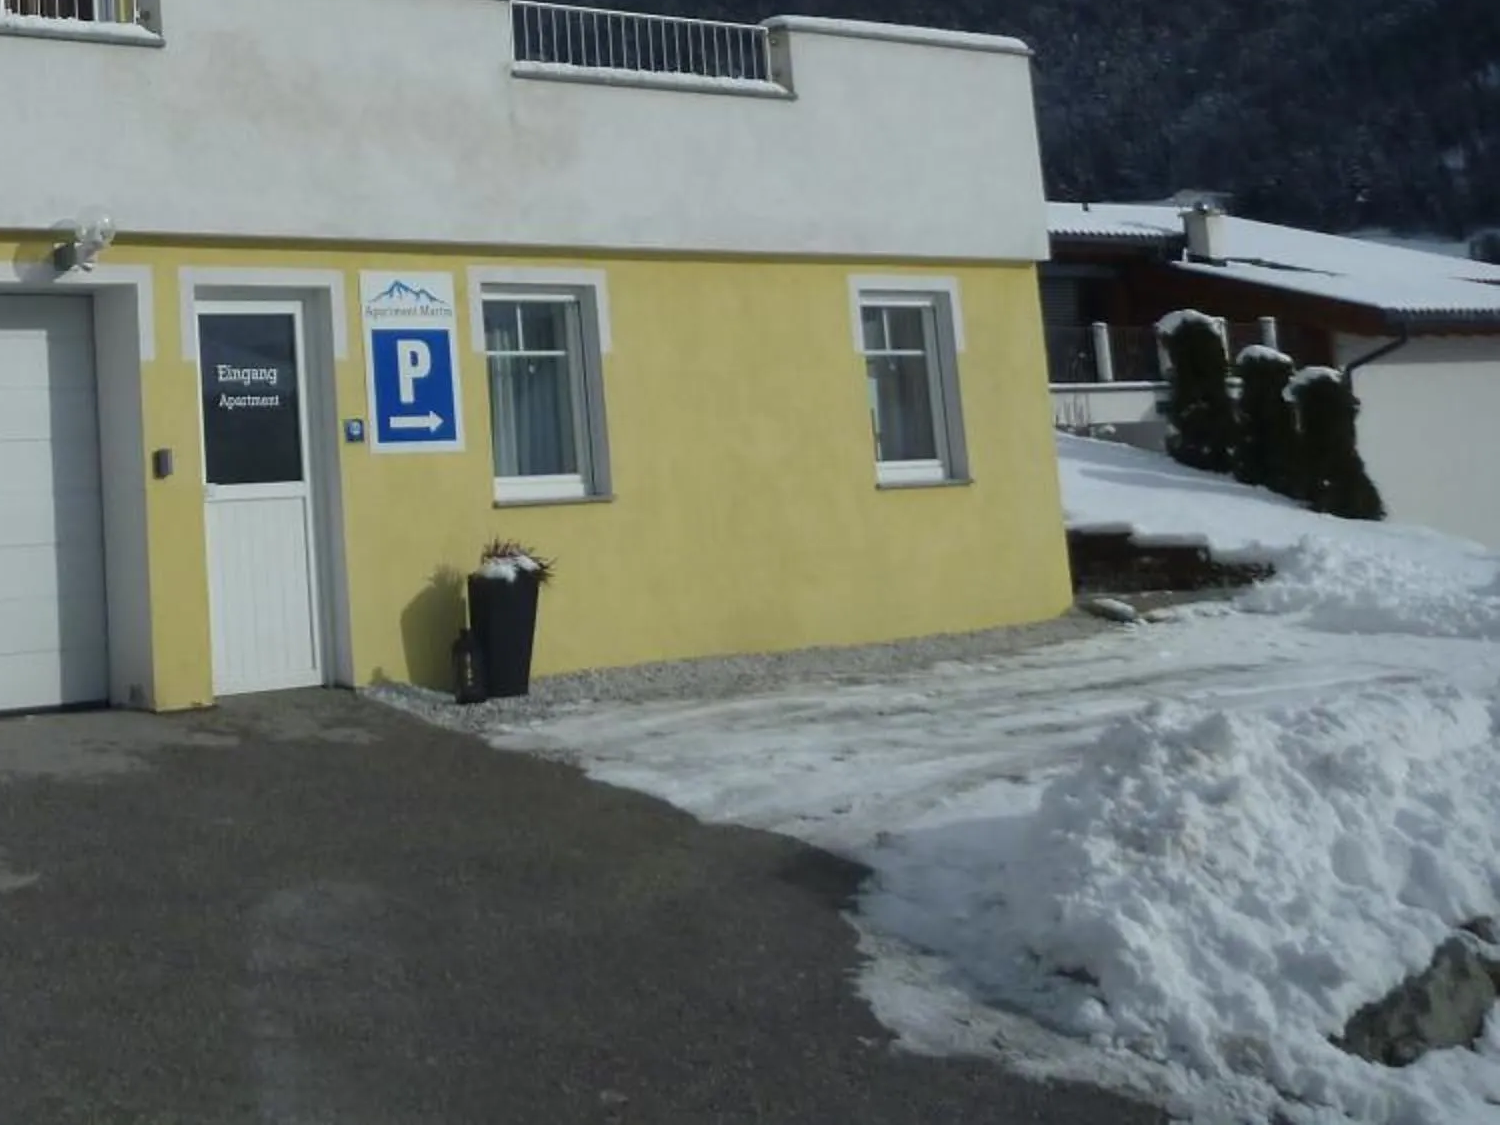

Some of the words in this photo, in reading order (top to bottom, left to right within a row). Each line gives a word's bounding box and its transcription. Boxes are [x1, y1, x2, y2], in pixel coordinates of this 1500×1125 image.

[365, 305, 417, 321] Apartment
[216, 364, 278, 385] Eingang
[396, 338, 432, 404] P
[218, 393, 280, 410] Apartment
